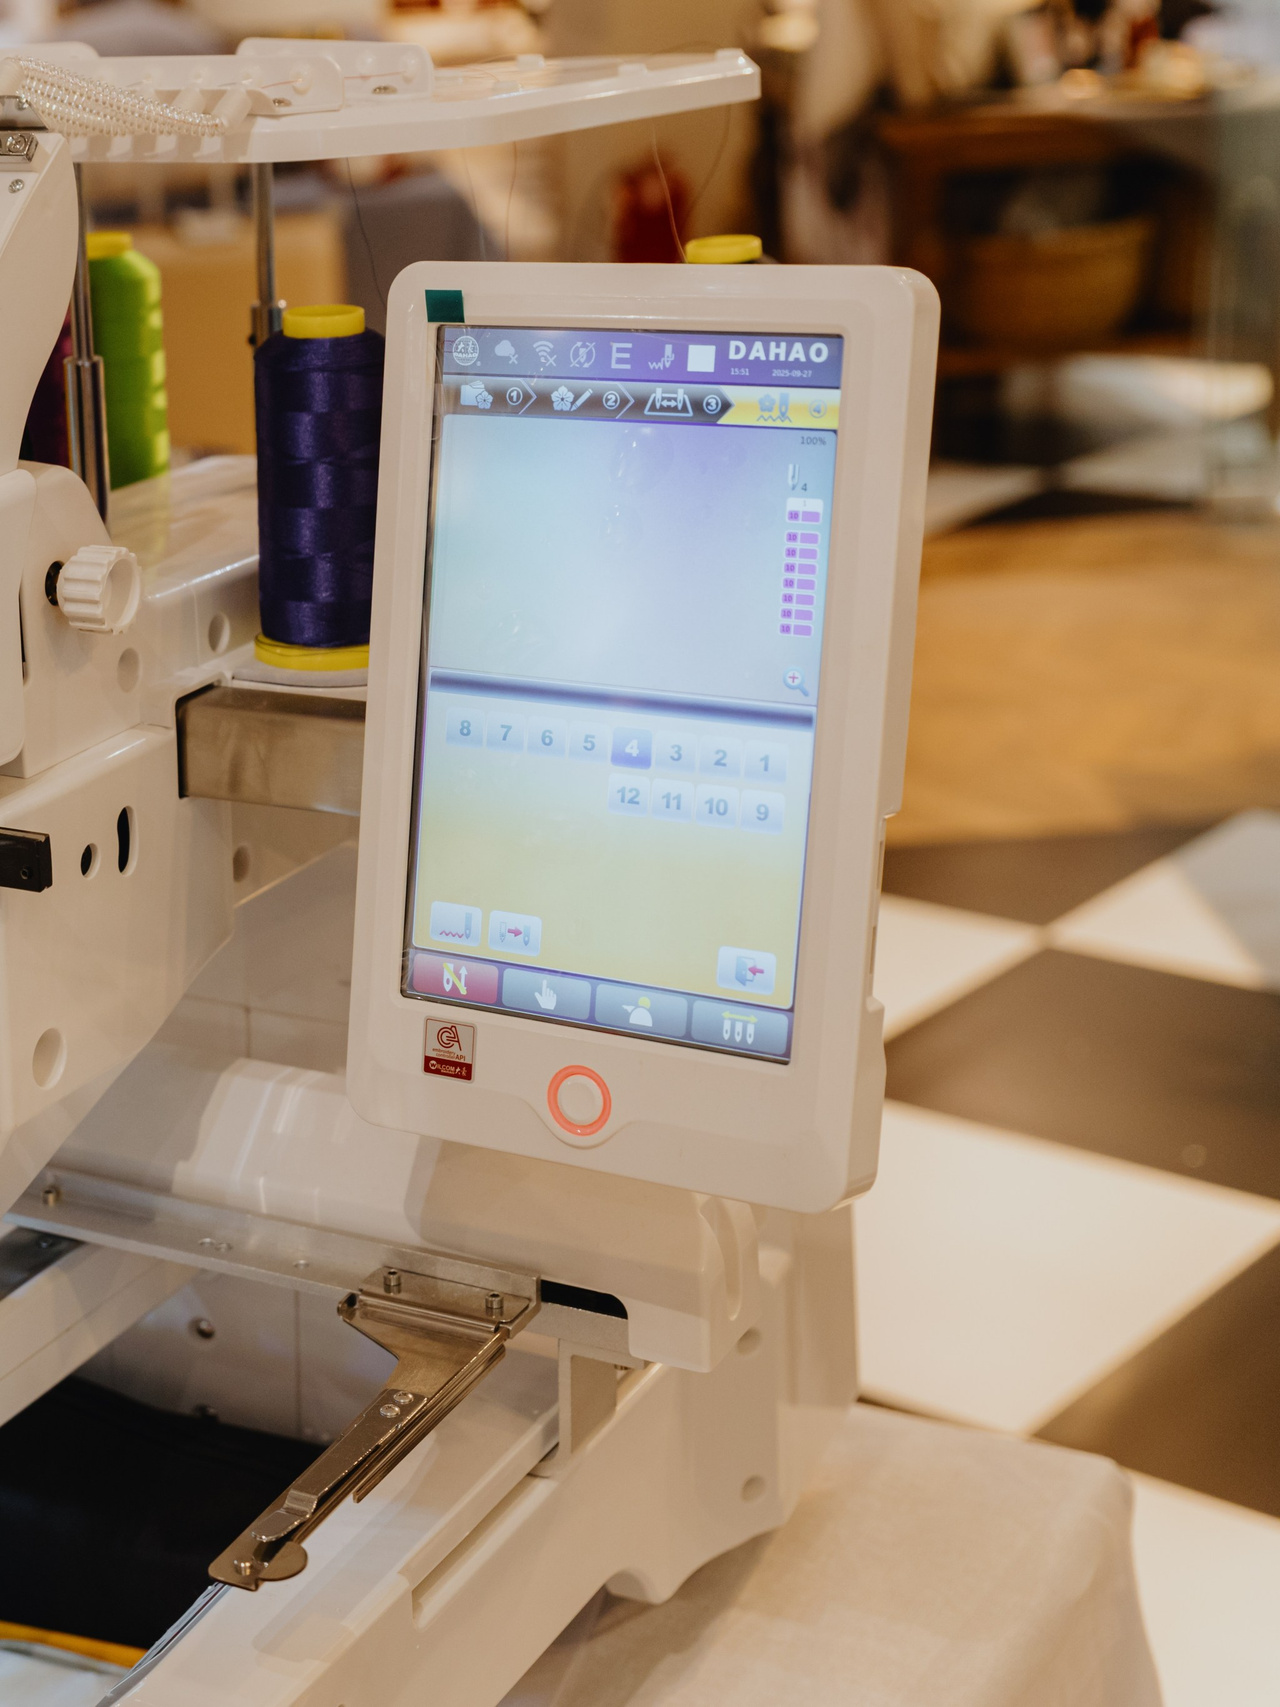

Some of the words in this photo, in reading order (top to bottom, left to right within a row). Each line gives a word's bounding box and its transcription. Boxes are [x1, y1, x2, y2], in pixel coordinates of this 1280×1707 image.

[728, 340, 829, 363] DAHAO
[730, 368, 750, 376] 15:51
[772, 369, 813, 378] 2025-09-27
[800, 436, 827, 446] 100%
[801, 483, 808, 492] 4
[459, 720, 472, 737] 8
[500, 724, 513, 741] 7
[541, 729, 554, 746] 6
[582, 734, 596, 751] 5
[625, 739, 639, 757] 4
[669, 744, 683, 761] 3
[713, 749, 727, 767] 2
[759, 754, 770, 772] 1
[616, 786, 640, 805] 12
[661, 792, 682, 810] 11
[704, 797, 729, 816] 10
[755, 804, 769, 821] 9
